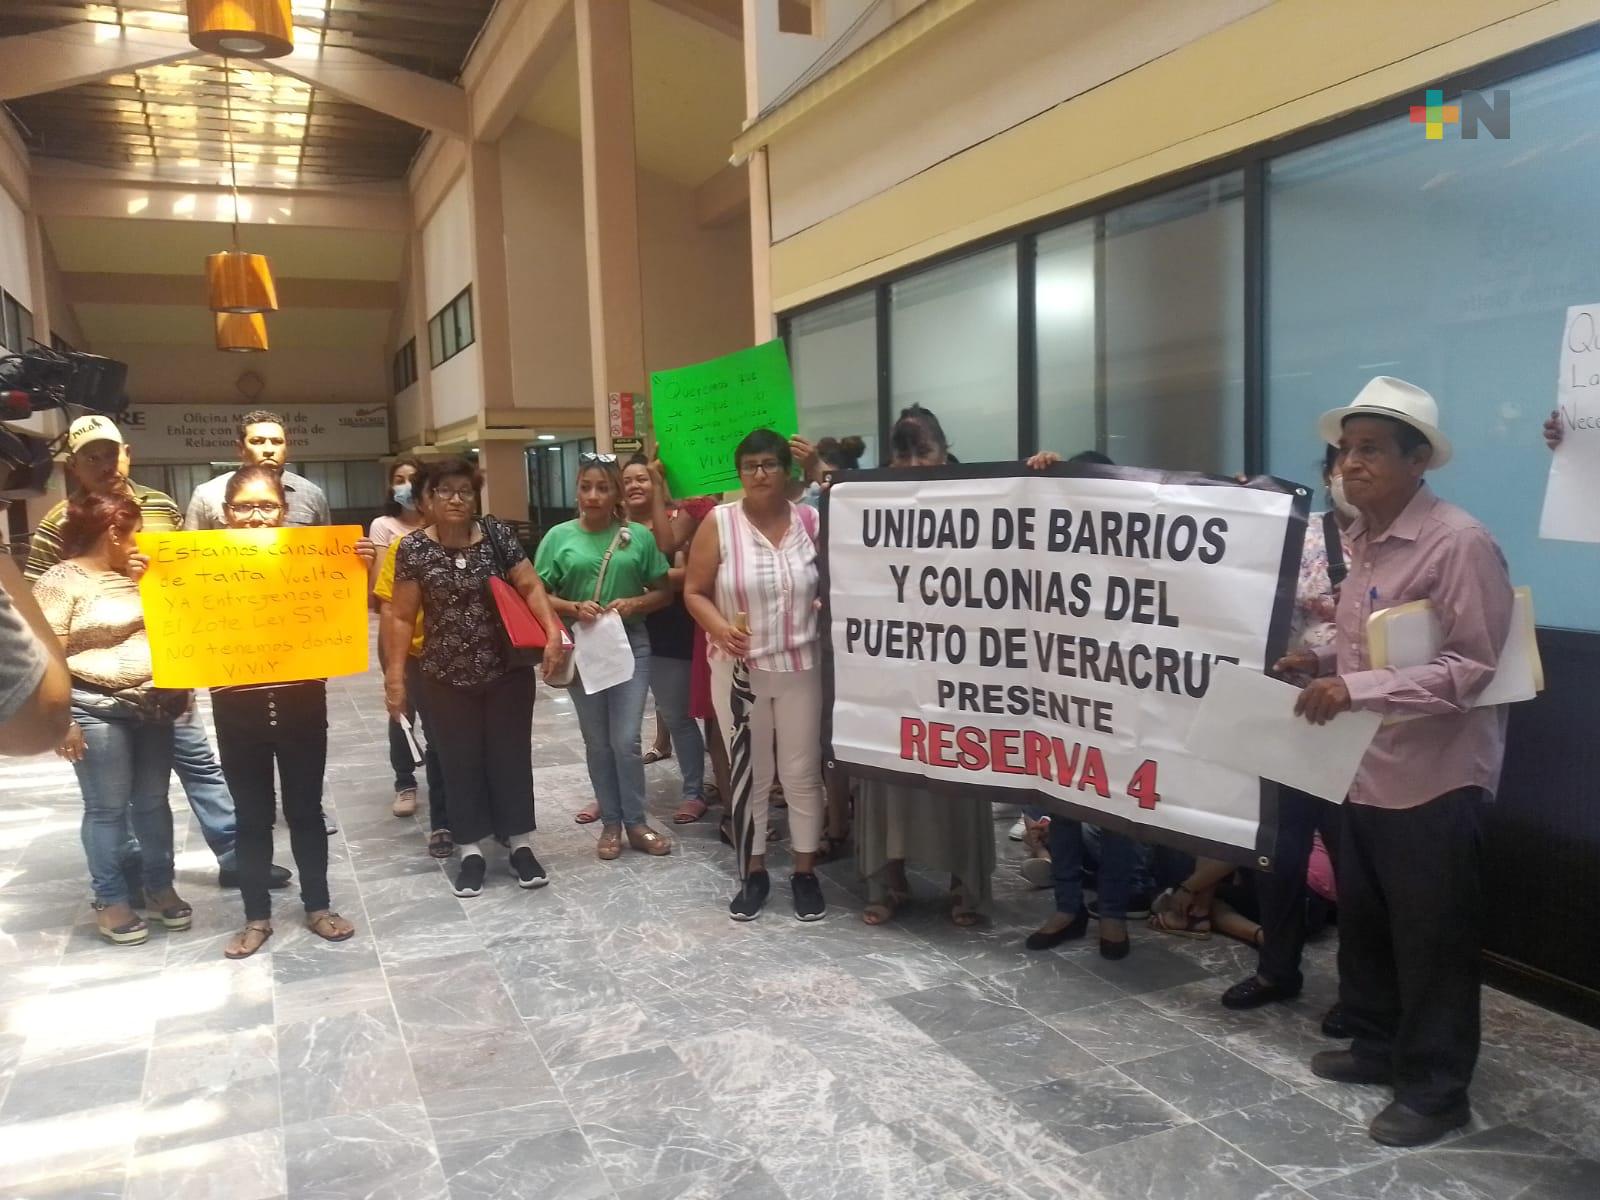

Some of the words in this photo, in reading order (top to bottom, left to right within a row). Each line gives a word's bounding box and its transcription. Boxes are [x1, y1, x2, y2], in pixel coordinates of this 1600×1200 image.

[116, 411, 145, 425] RE
[167, 425, 210, 436] Enlace
[212, 427, 231, 436] con
[312, 424, 325, 434] de
[184, 413, 227, 423] Oficina
[294, 412, 308, 423] de
[185, 438, 236, 448] Relacion
[862, 508, 980, 549] UNIDAD
[991, 508, 1036, 550] DE
[1047, 508, 1229, 565] BARRIOS
[156, 537, 258, 563] Estamos
[160, 570, 186, 588] de
[195, 564, 267, 585] tanta
[889, 565, 911, 604] Y
[919, 565, 1092, 618] COLONIAS
[1104, 576, 1180, 628] DEL
[206, 639, 294, 656] tenemos
[301, 629, 353, 650] donde
[846, 617, 967, 665] PUERTO
[979, 627, 1029, 669] DE
[1033, 630, 1240, 699] VERACRU
[937, 679, 1114, 735] PRESENTE
[900, 716, 1111, 799] RESERVA
[1126, 759, 1161, 811] 4
